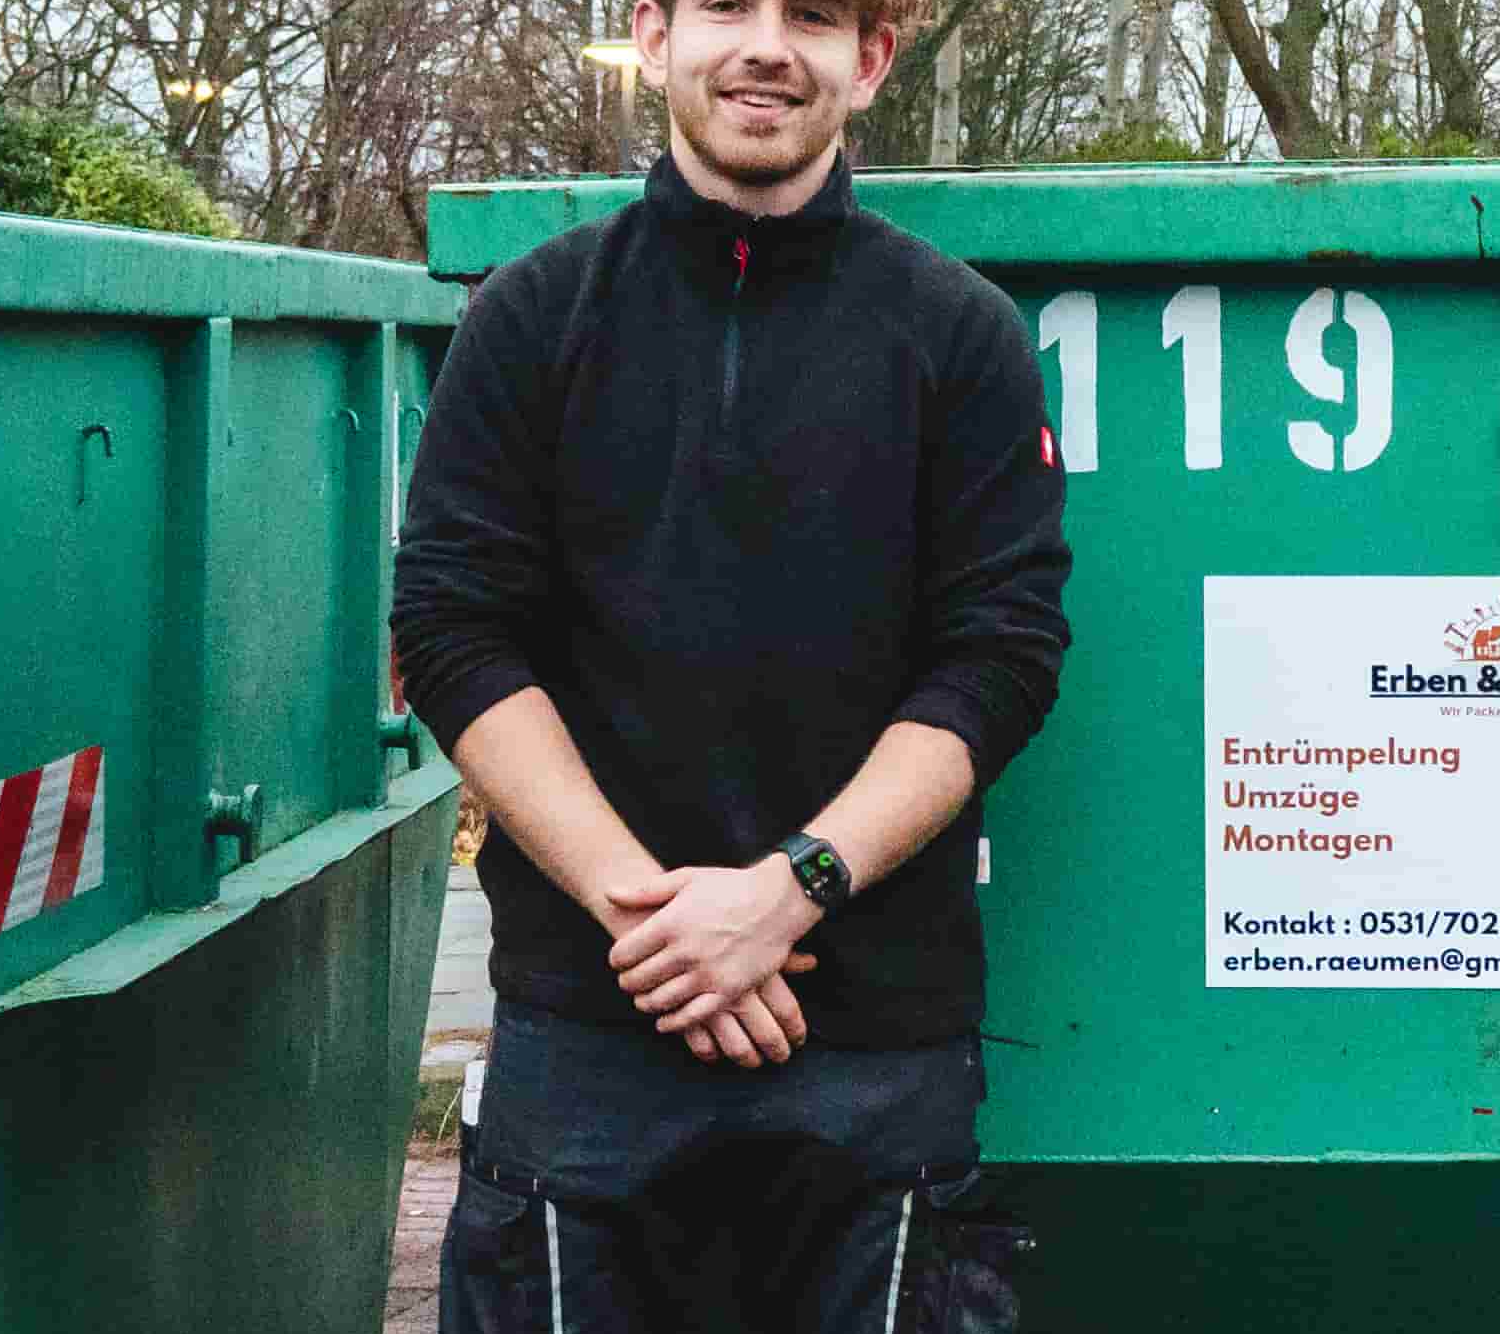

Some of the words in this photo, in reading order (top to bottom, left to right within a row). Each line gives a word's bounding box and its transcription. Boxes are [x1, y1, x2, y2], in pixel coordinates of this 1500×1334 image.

[1370, 663, 1467, 693] Erben
[1223, 736, 1461, 773] Entrümpelung
[1223, 780, 1360, 816] Umzüge
[1222, 824, 1394, 860] Montagen
[1223, 910, 1336, 935] Kontakt
